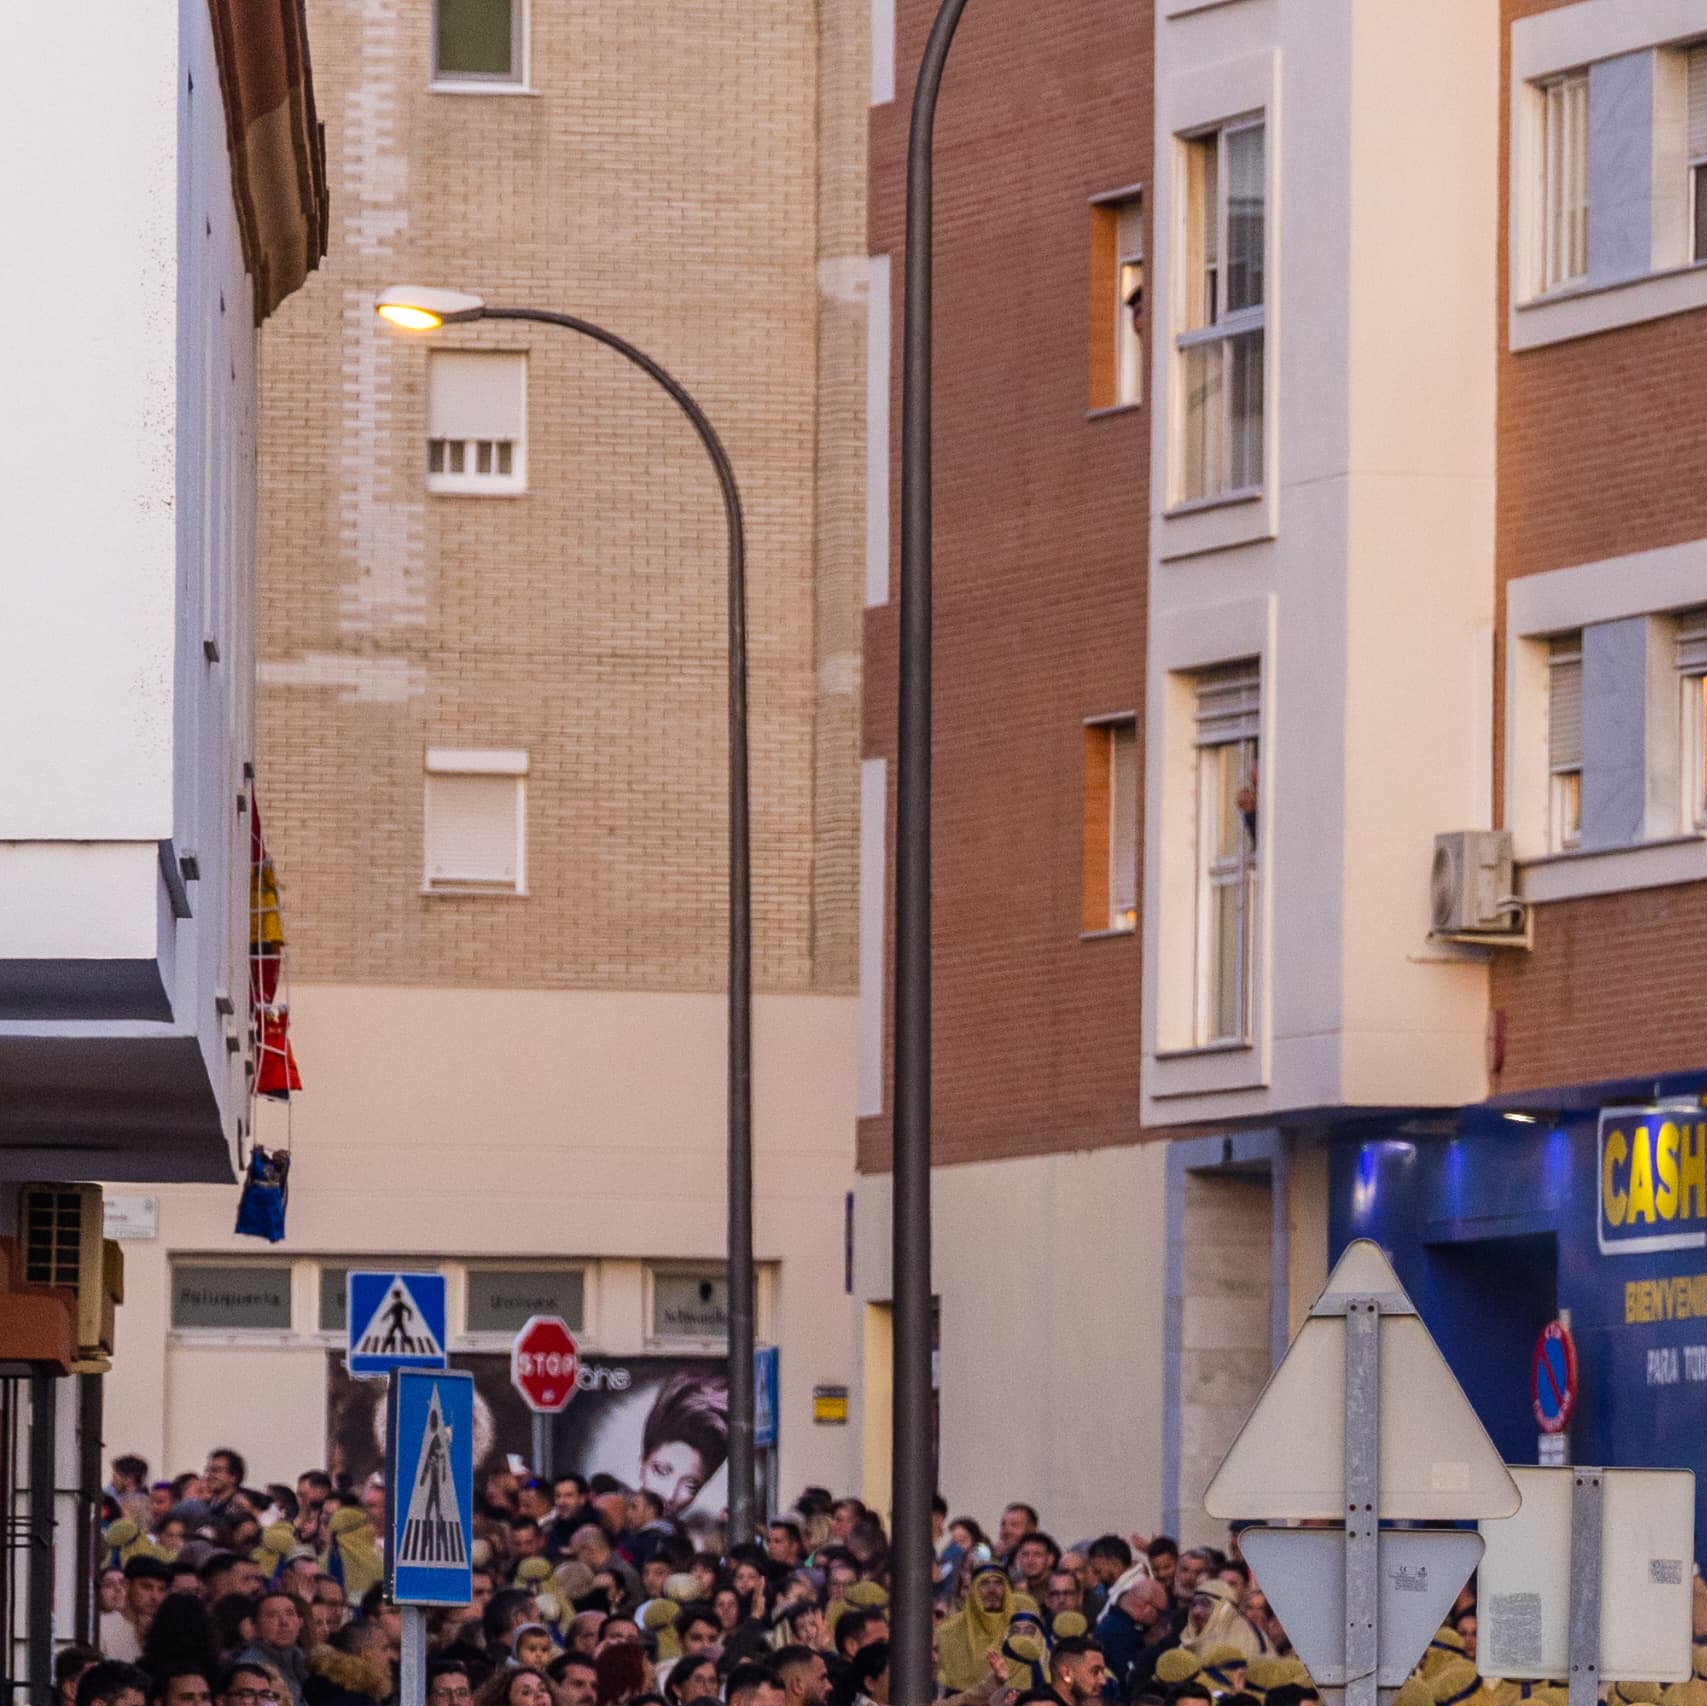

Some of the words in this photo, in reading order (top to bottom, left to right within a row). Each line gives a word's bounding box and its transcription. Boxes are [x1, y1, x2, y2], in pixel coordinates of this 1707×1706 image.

[1603, 1121, 1707, 1227] CASH
[519, 1352, 577, 1377] STOP
[1647, 1347, 1679, 1385] PARA
